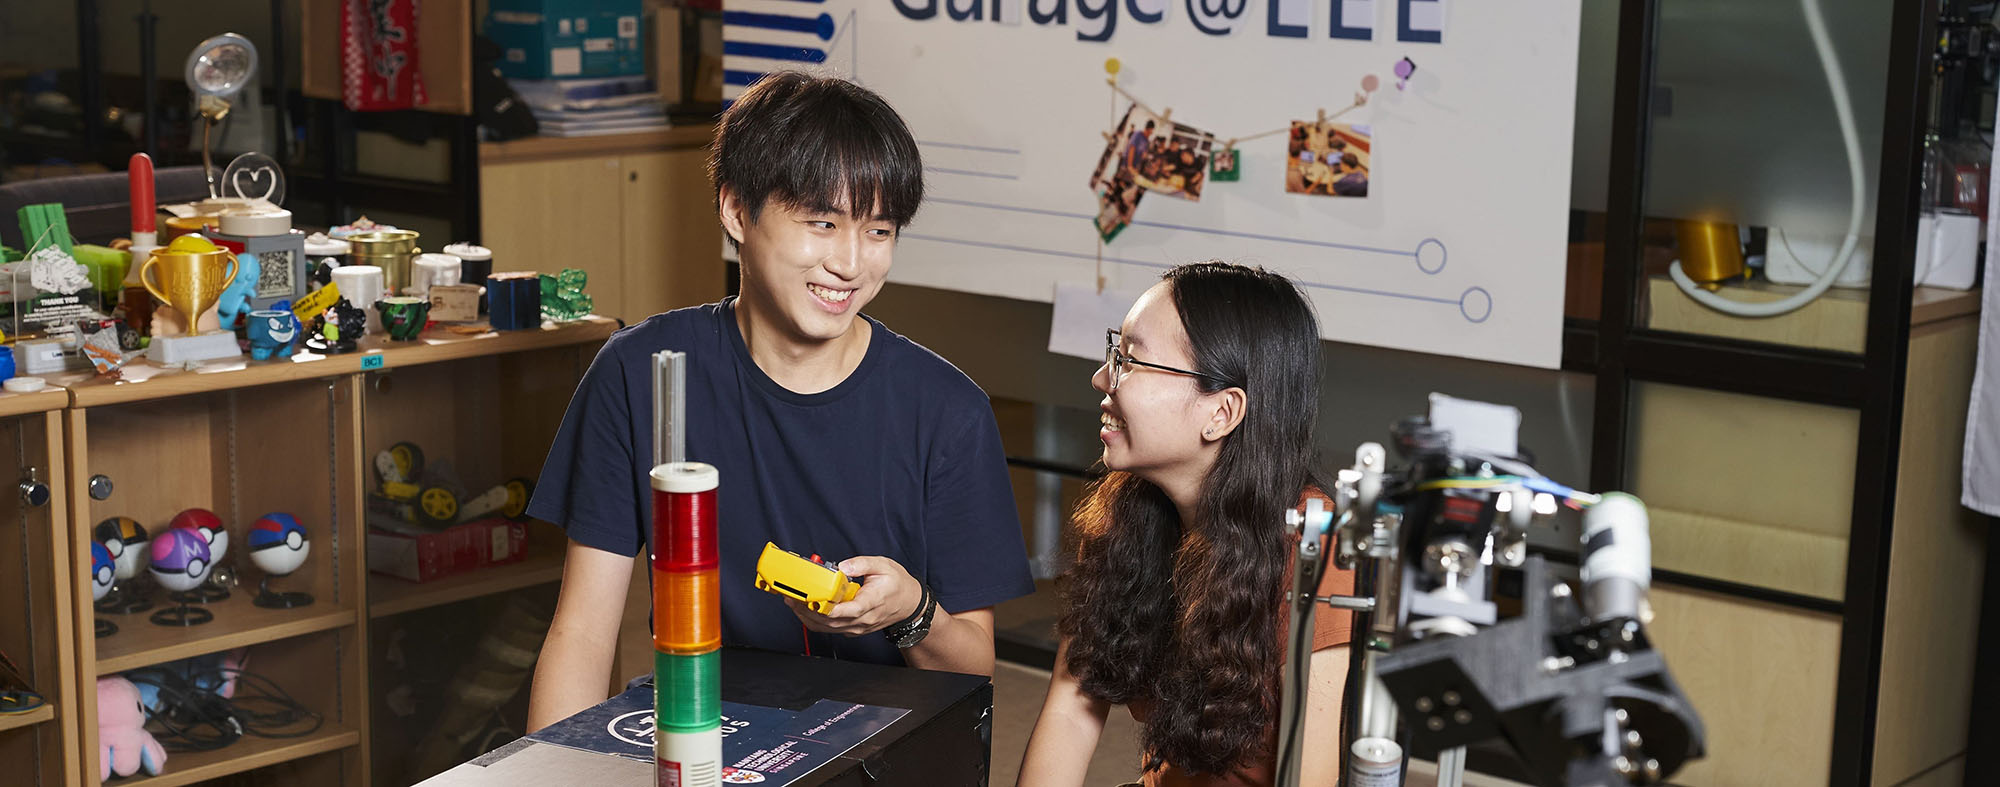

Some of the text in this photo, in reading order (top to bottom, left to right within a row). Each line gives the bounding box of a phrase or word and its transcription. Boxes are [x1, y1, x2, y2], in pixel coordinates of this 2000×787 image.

[40, 296, 79, 306] THANK YOU
[184, 541, 202, 557] M
[802, 723, 826, 737] College
[828, 704, 865, 724] Engineering
[732, 749, 768, 768] NANYANG
[742, 740, 798, 770] TECHNOLOGICAL
[753, 749, 795, 772] UNIVERSITY
[769, 752, 809, 774] SINGAPORE
